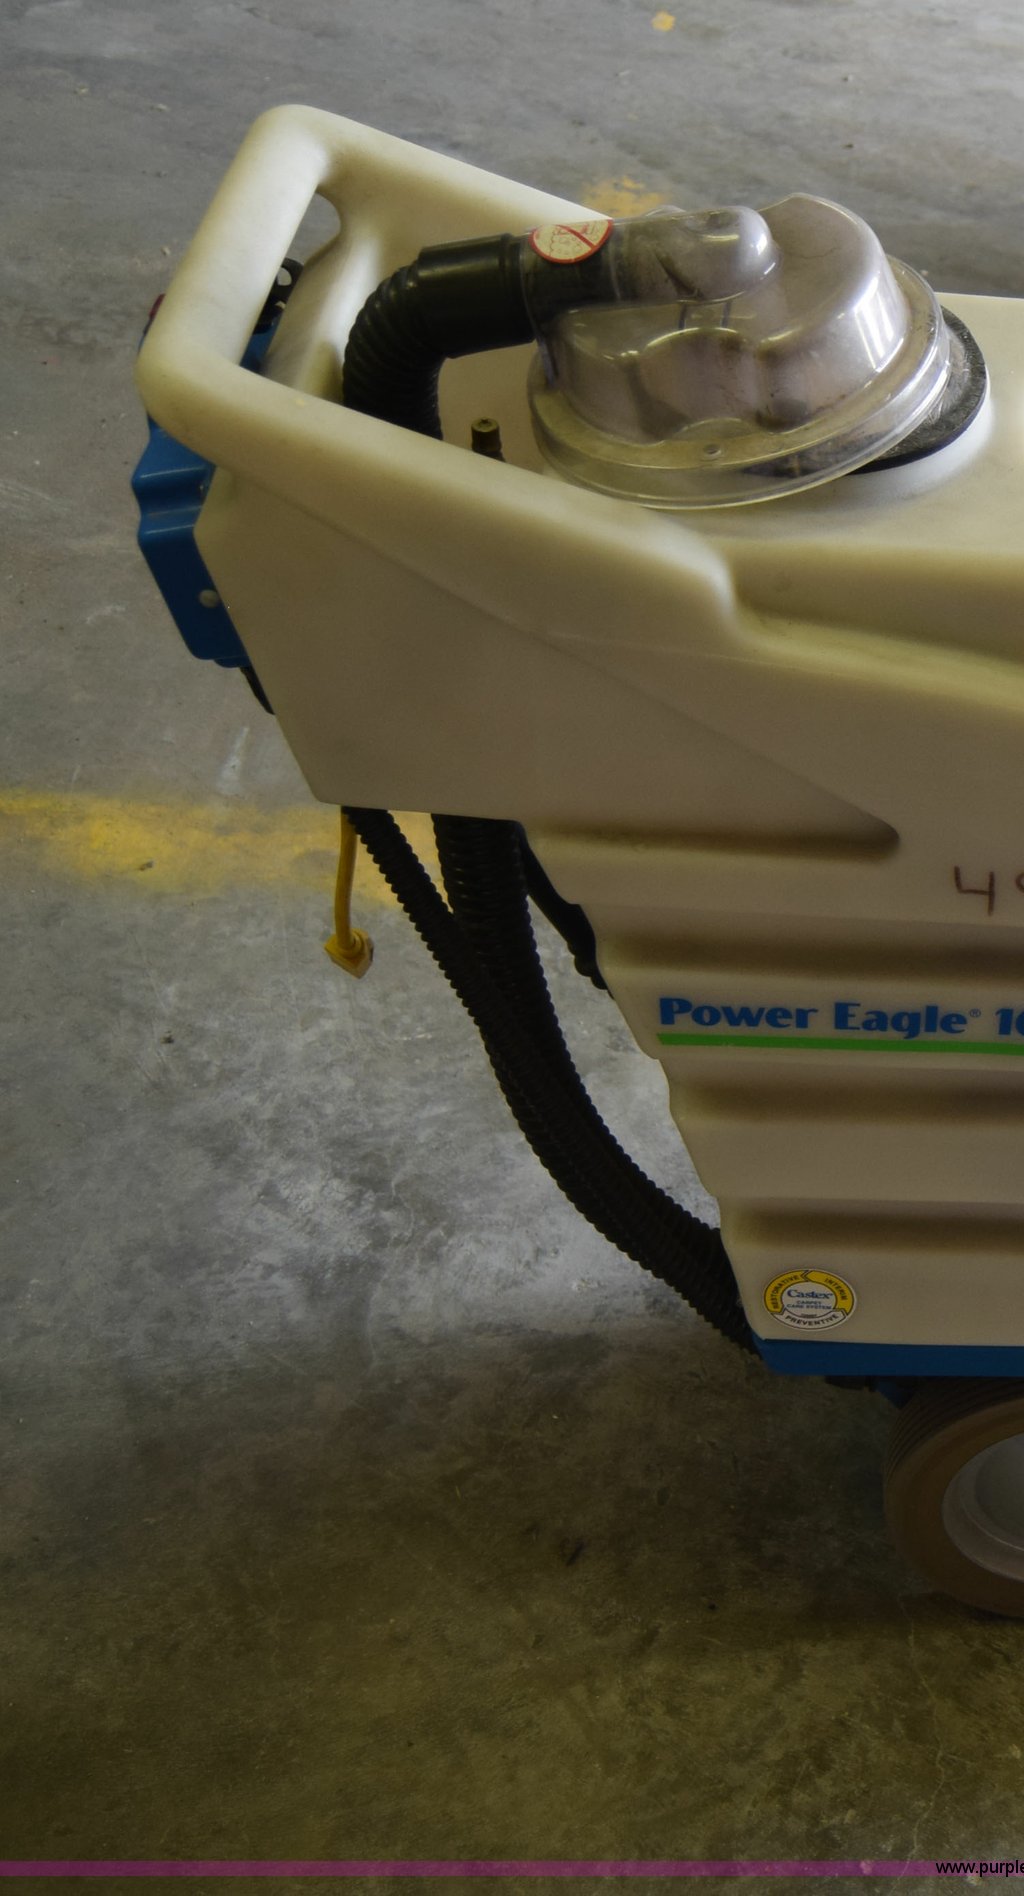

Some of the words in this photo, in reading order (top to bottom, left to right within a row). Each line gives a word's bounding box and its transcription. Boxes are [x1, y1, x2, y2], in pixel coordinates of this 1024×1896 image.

[658, 997, 819, 1029] Power
[787, 1289, 831, 1299] Castex
[785, 1314, 839, 1326] PREVENTIVE
